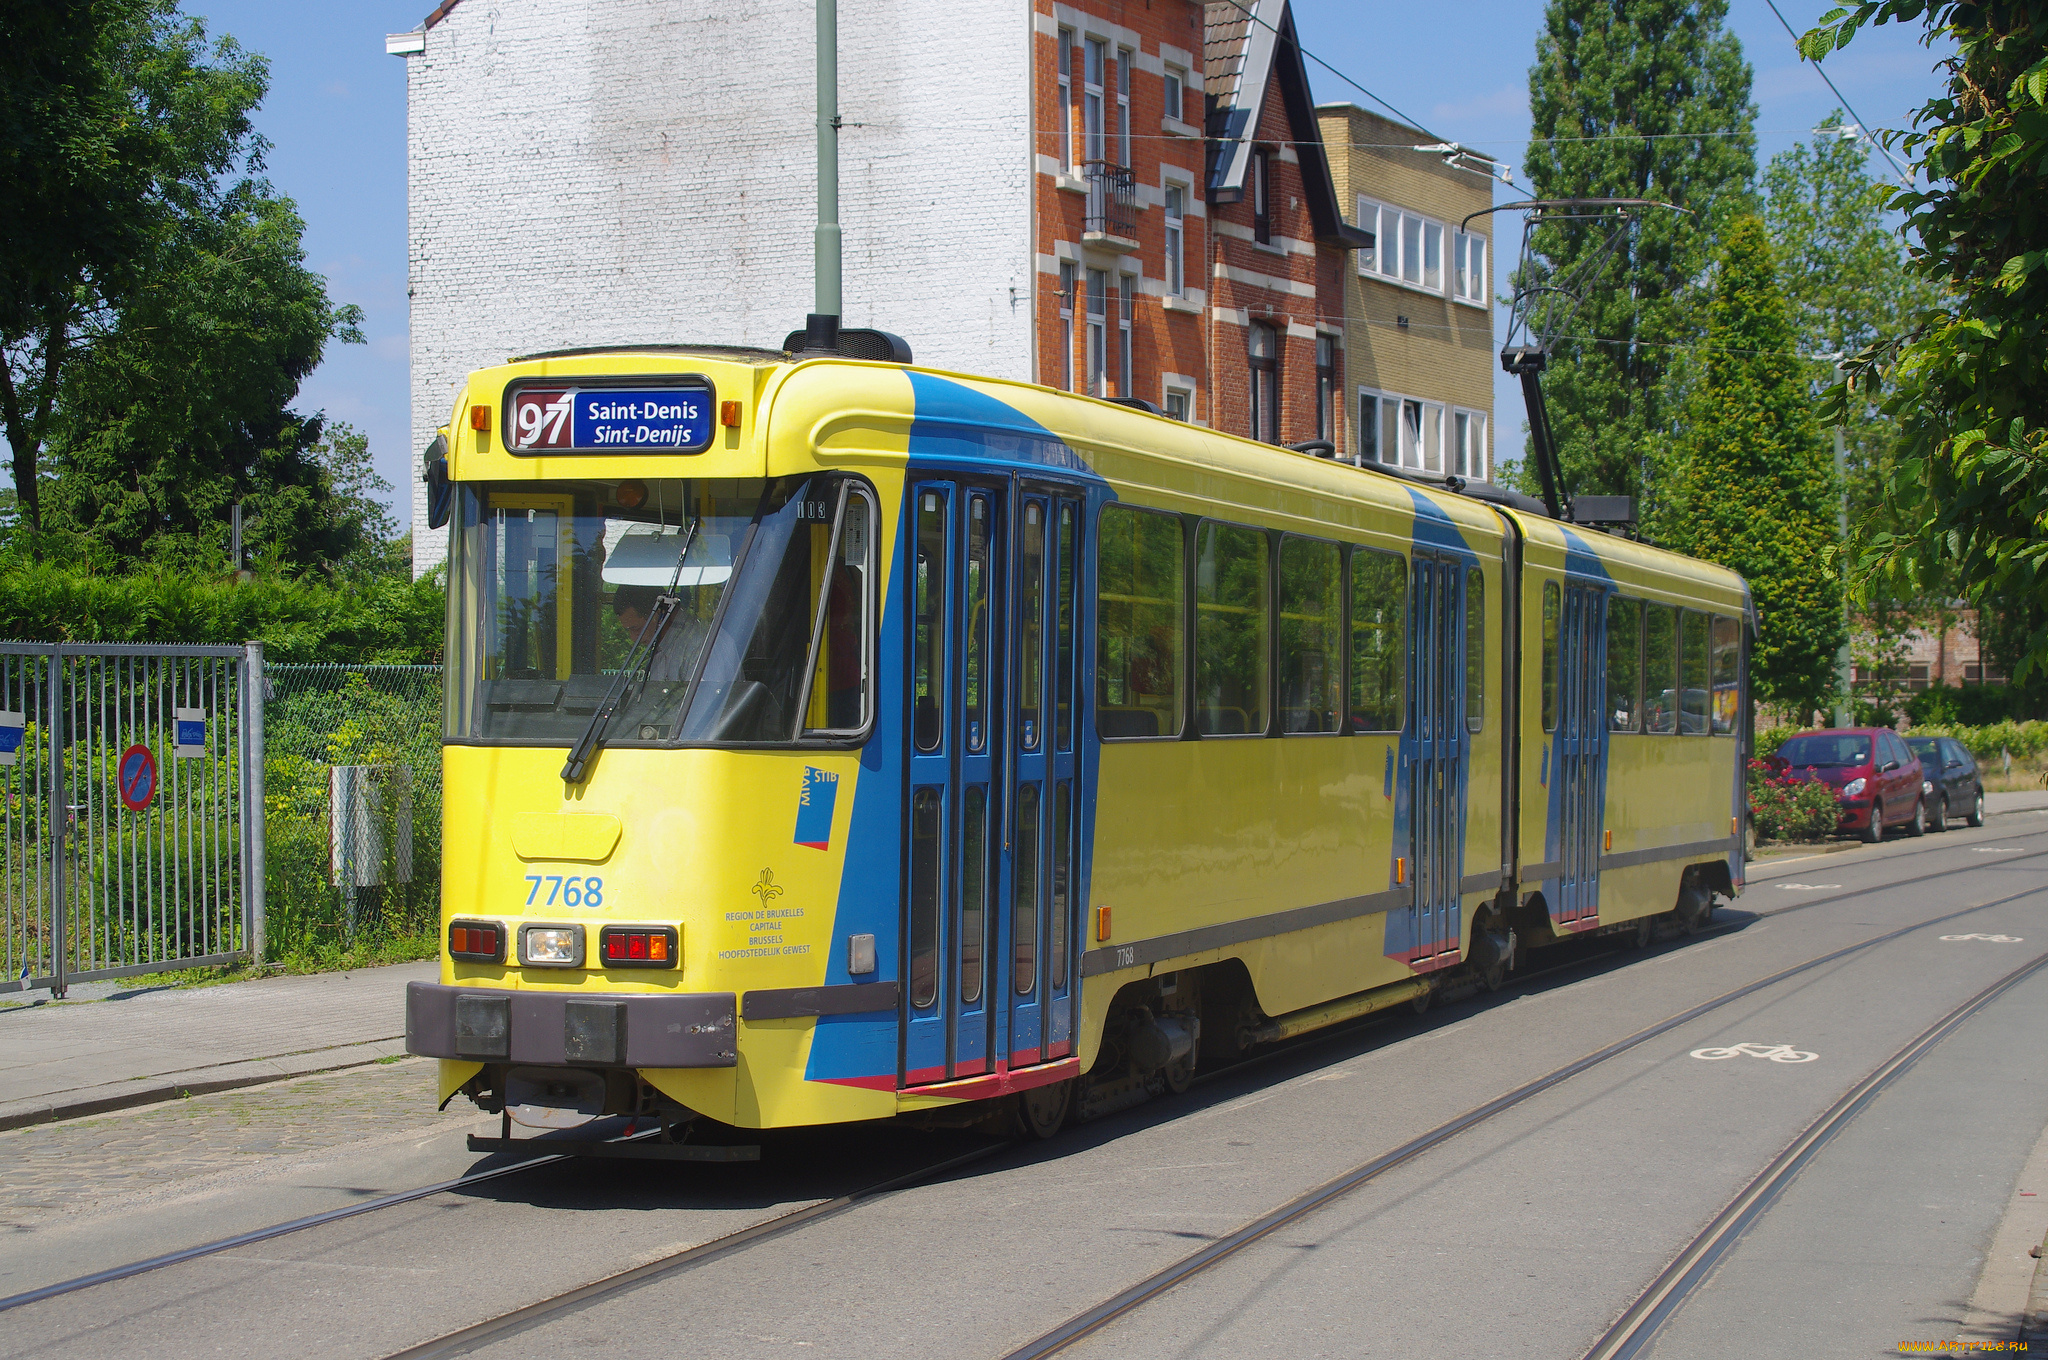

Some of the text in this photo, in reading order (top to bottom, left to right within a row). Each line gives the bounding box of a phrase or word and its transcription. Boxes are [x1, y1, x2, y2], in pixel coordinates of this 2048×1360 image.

[588, 401, 698, 421] Saint-Denis
[518, 402, 571, 446] 97
[593, 425, 692, 447] Sint-Denijs
[814, 770, 837, 783] STIB
[525, 875, 604, 908] 7768
[725, 908, 805, 922] REGION DE BRUXELLES
[749, 921, 783, 932] CAPITALE
[748, 935, 784, 946] BRUSSELS
[718, 944, 811, 960] HOOFDSTEDELIJK GEWEST
[1116, 946, 1135, 967] 7768
